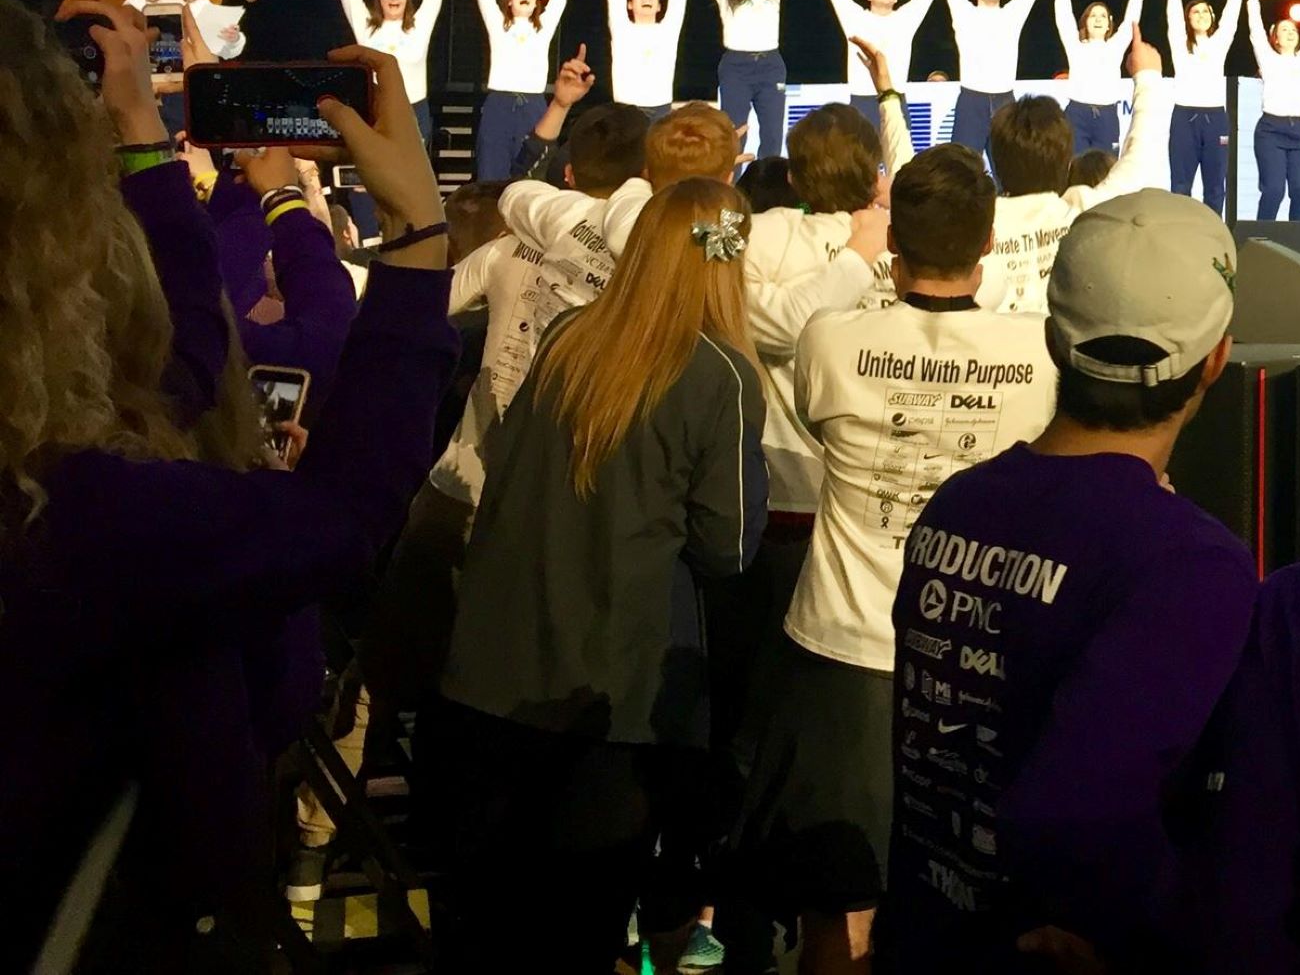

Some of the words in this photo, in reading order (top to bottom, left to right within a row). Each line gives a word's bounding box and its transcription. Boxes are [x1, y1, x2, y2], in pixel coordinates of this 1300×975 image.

[857, 349, 916, 380] United
[920, 356, 960, 384] With
[965, 359, 1033, 389] Purpose
[888, 392, 943, 407] SUBWAY
[950, 394, 997, 410] DELL
